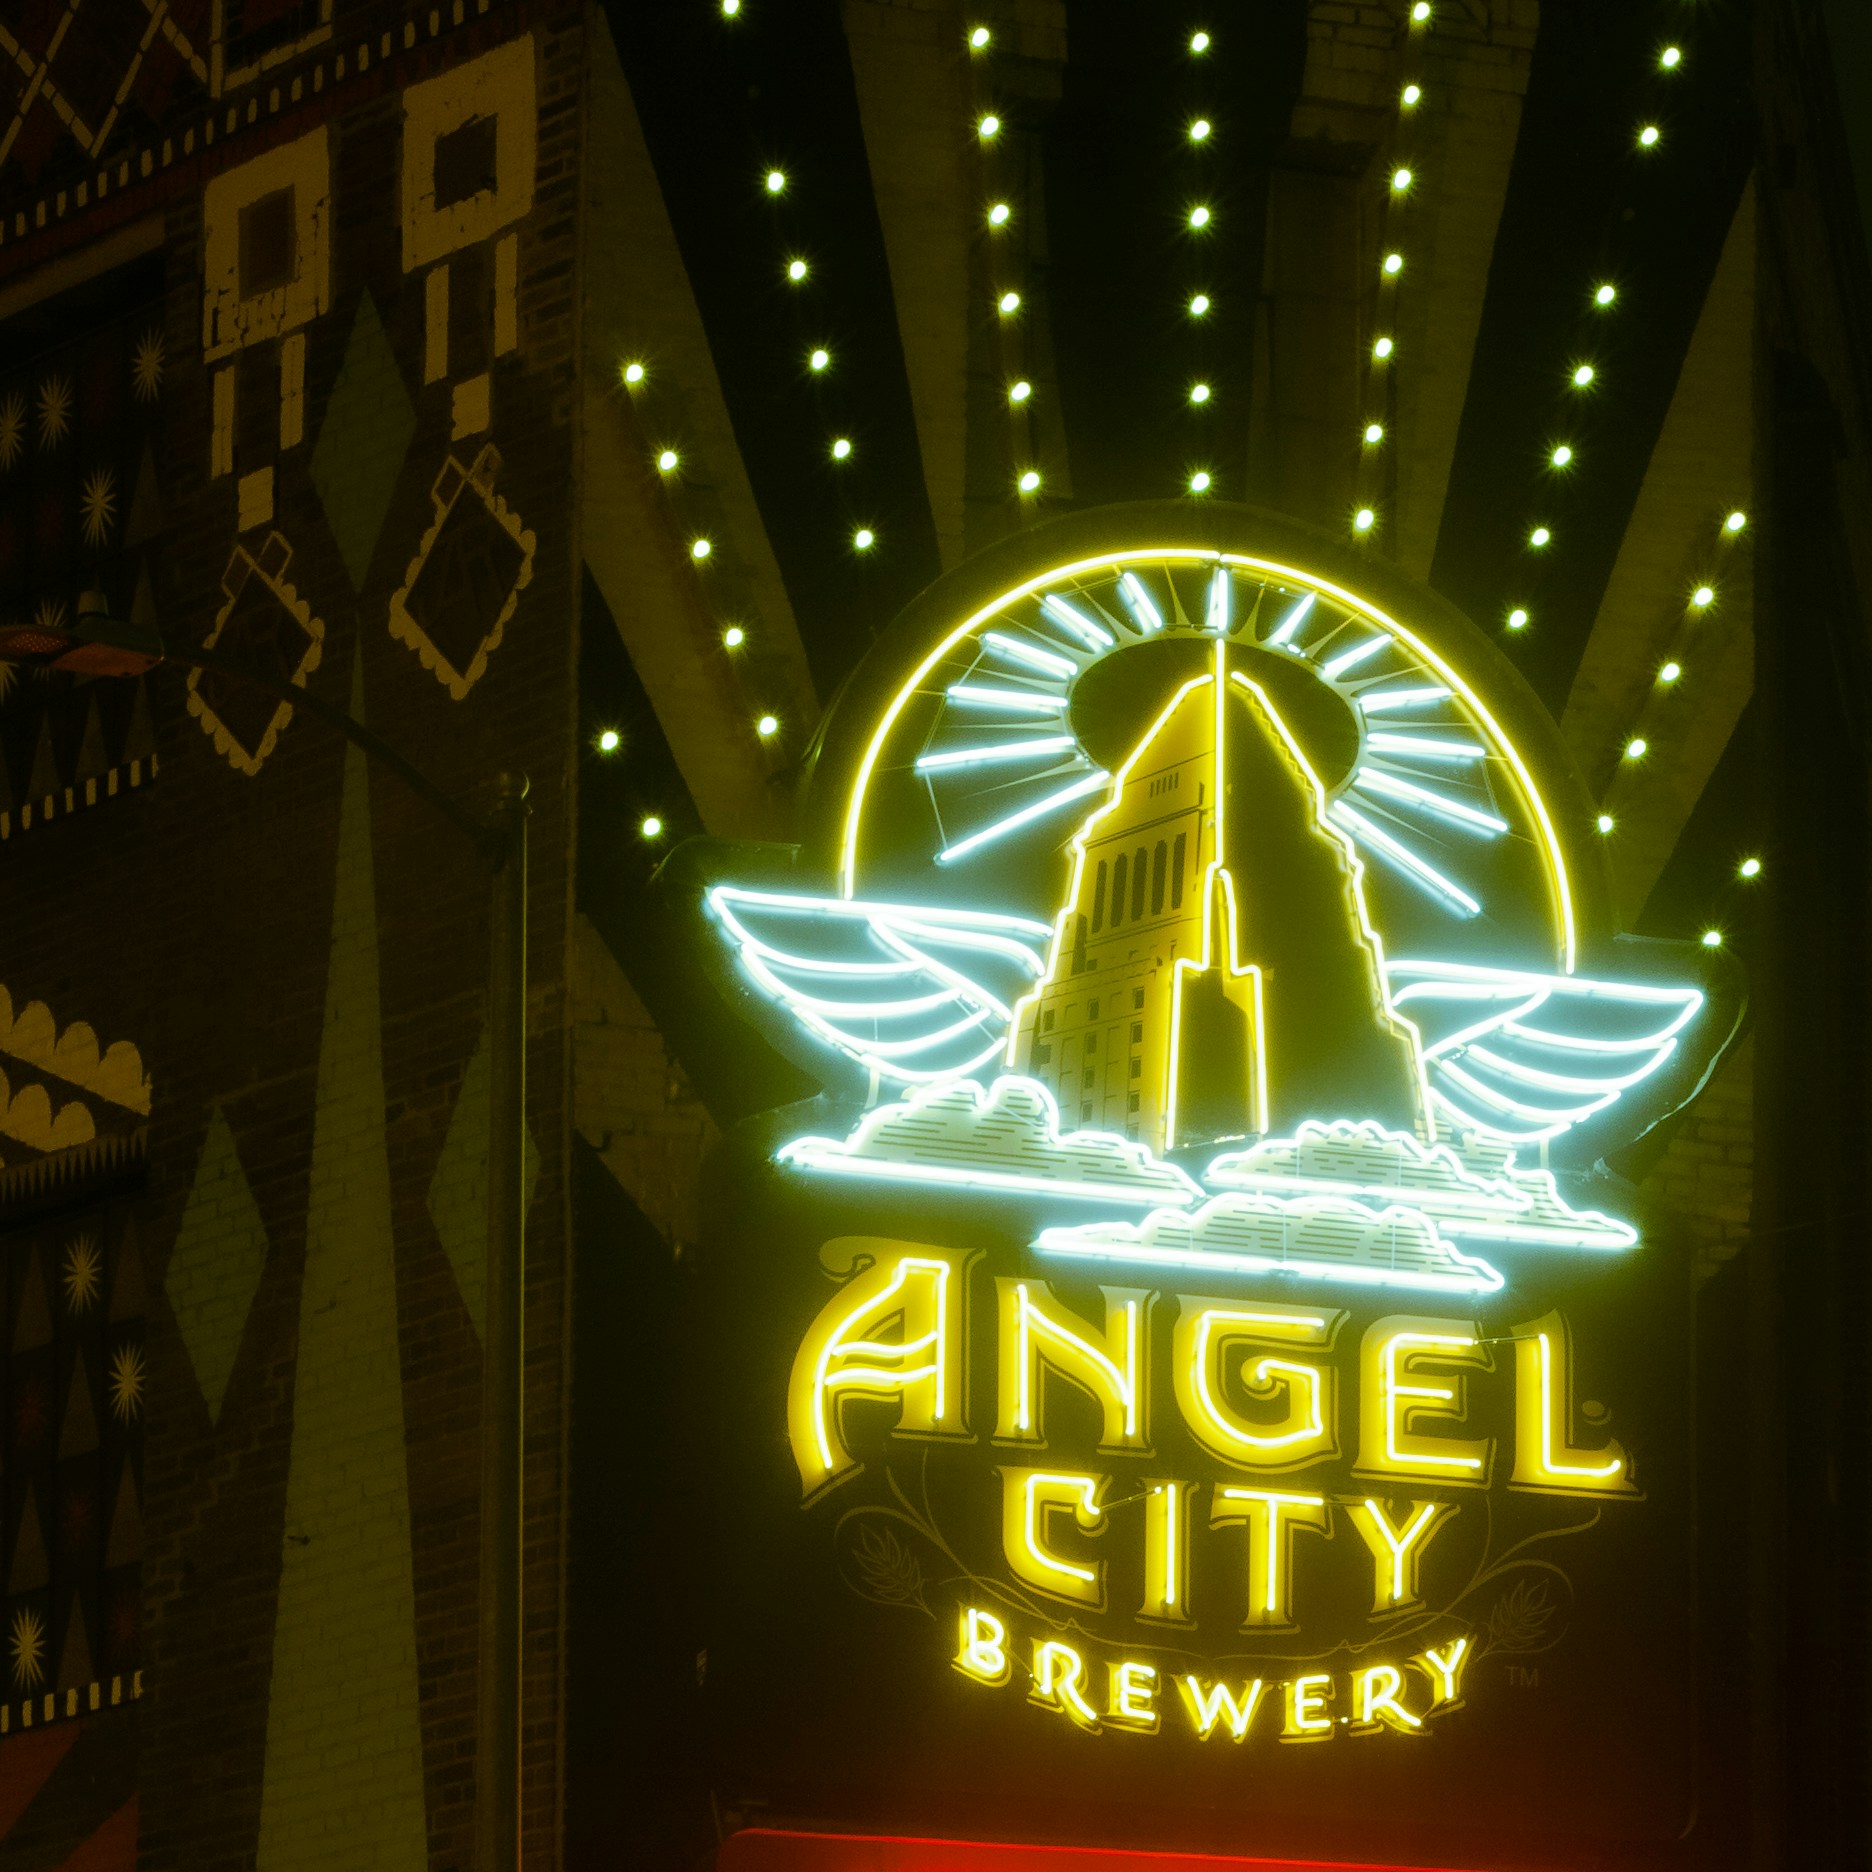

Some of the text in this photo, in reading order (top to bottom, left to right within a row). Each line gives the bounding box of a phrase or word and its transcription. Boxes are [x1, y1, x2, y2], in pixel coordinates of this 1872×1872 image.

[790, 1236, 1646, 1508] ANGEL
[998, 1464, 1460, 1636] CITY
[950, 1600, 1478, 1746] BREWERY
